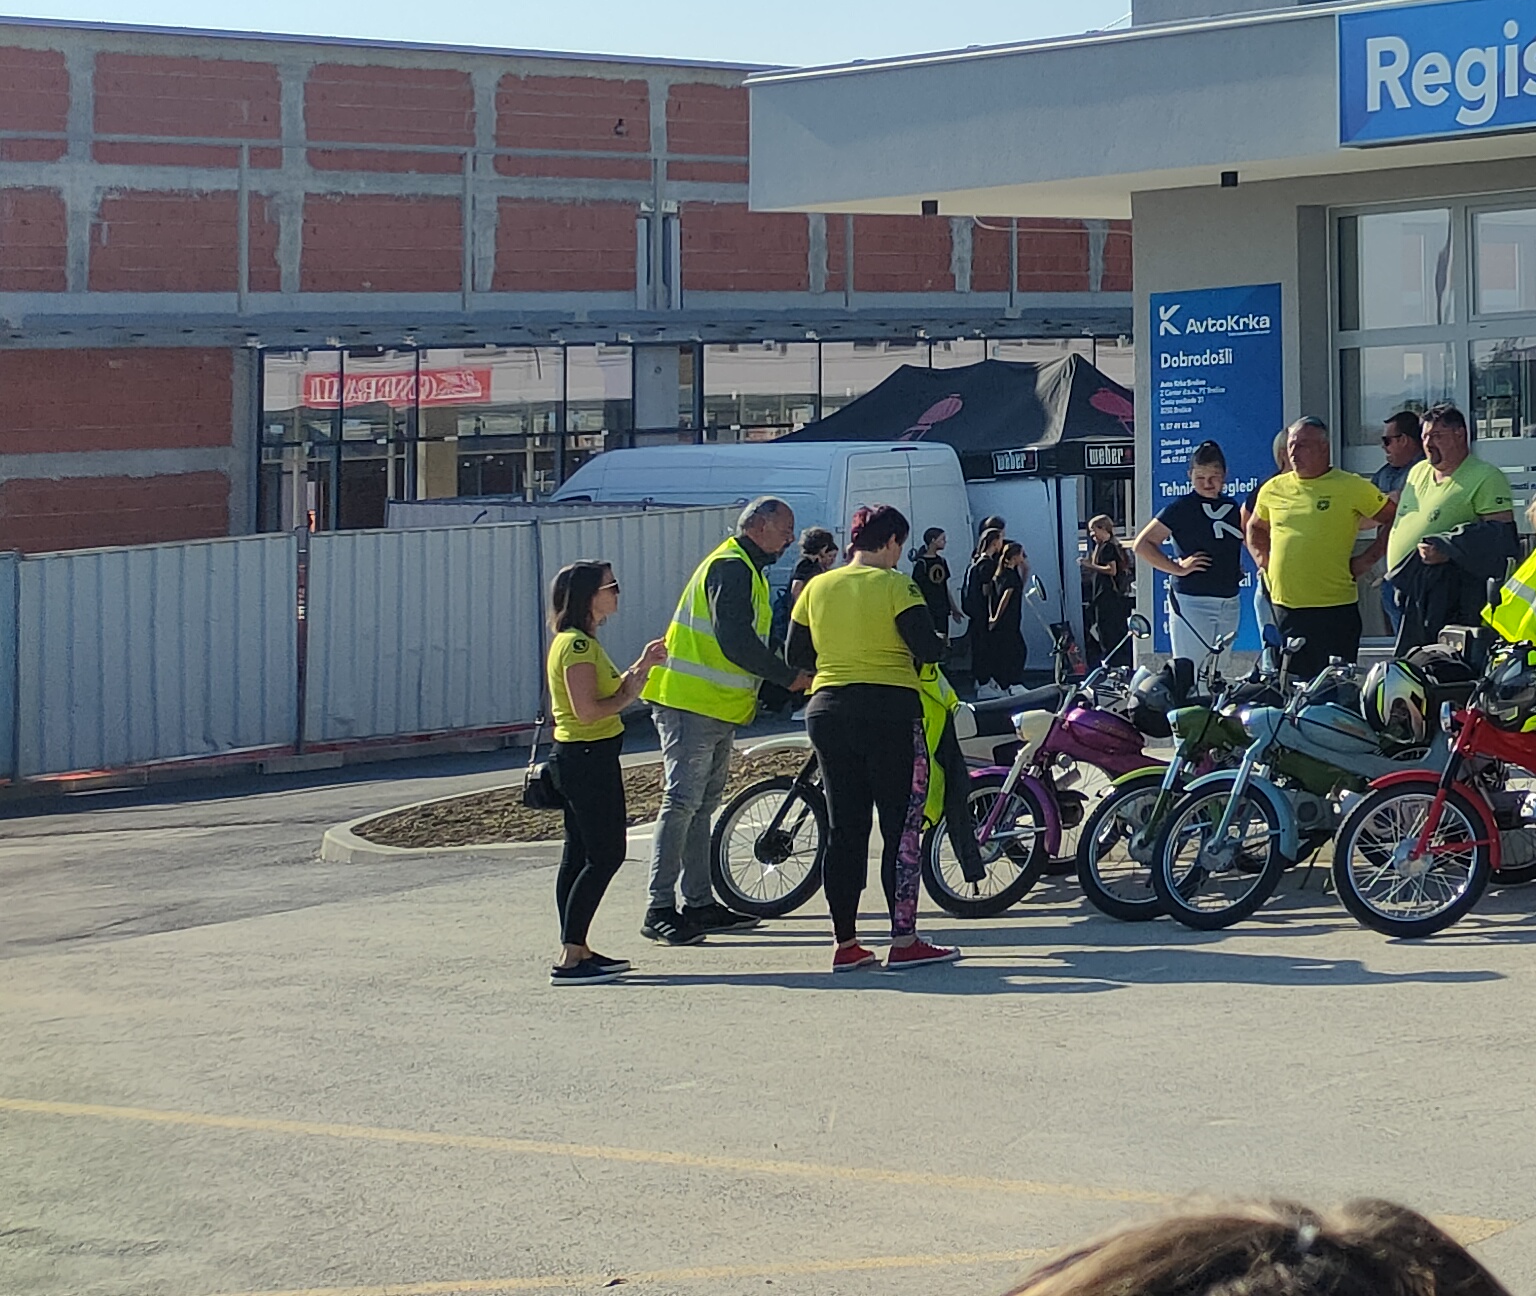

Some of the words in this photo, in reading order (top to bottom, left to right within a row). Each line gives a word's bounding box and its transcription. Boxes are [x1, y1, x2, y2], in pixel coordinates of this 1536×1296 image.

[1185, 313, 1271, 335] AvtoKrka
[1160, 348, 1233, 369] Dobrodošli
[1089, 444, 1124, 465] weber
